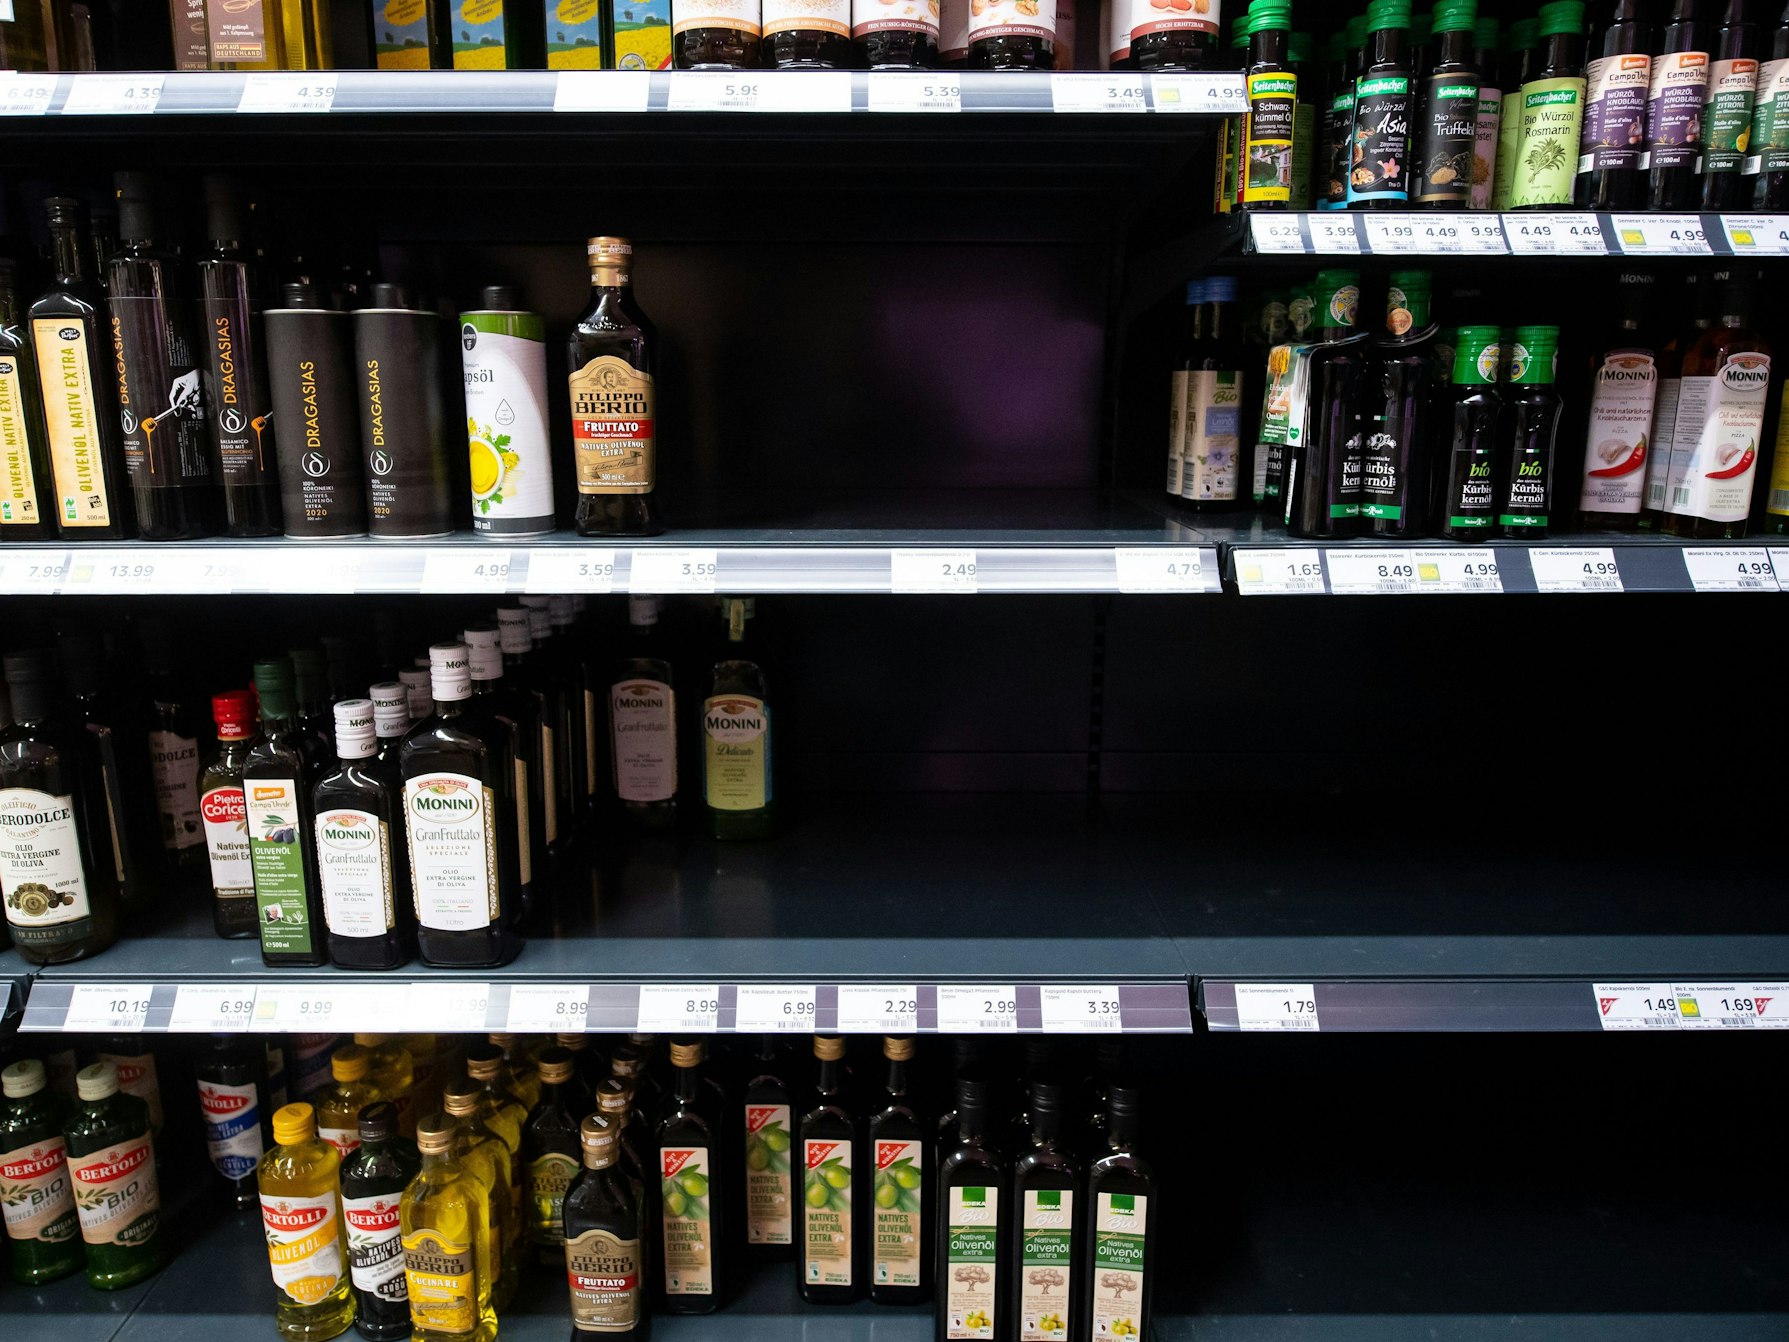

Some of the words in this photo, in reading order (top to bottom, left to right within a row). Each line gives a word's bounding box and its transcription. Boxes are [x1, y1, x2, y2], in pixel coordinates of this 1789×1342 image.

[1174, 21, 1204, 29] ERHITZBAR
[924, 86, 961, 97] 5.39
[1253, 80, 1295, 93] Seitenbacher
[1357, 80, 1406, 96] Seitenbacher
[1438, 86, 1477, 97] Seitenbacher
[1665, 87, 1693, 97] WÜRZÖL
[298, 87, 335, 98] 4.39
[1108, 88, 1144, 98] 3.49
[1207, 88, 1244, 98] 4.99
[1607, 90, 1635, 99] WÜRZÖL
[1717, 94, 1745, 102] WÜRZÖL
[1527, 93, 1574, 106] Seitenbacher
[1716, 101, 1745, 109] ZITRONE
[1259, 102, 1291, 112] Schwarz-
[1360, 104, 1371, 114] Bio
[1255, 114, 1283, 123] kümmel
[1434, 114, 1449, 122] Bio
[1524, 115, 1536, 125] Bio
[1541, 111, 1575, 122] Würzöl
[1377, 113, 1407, 135] Asia
[1525, 125, 1571, 138] Rosmarin
[1270, 227, 1300, 236] 6.29
[1325, 227, 1355, 236] 3.99
[1382, 227, 1412, 236] 1.99
[1426, 228, 1456, 237] 4.49
[1472, 227, 1502, 236] 9.99
[1521, 226, 1551, 236] 4.49
[1570, 226, 1600, 236] 4.49
[1670, 230, 1706, 241] 4.99
[111, 317, 130, 405] DRAGASIAS
[216, 317, 237, 405] DRAGASIAS
[61, 347, 80, 388] EXTRA
[1604, 371, 1650, 381] MONINI
[1726, 372, 1767, 382] MONINI
[579, 393, 643, 401] FILIPPO
[301, 362, 322, 448] DRAGASIAS
[368, 360, 385, 446] DRAGASIAS
[575, 402, 647, 413] BERIO
[67, 393, 85, 428] NATIV
[2, 416, 19, 446] NATIV
[584, 422, 639, 432] FRUTTATO
[601, 449, 624, 457] EXTRA
[1519, 461, 1542, 476] bio
[1463, 485, 1492, 494] Kürbis
[1512, 484, 1544, 493] Kürbis
[1511, 493, 1544, 502] kernöl
[29, 566, 63, 577] 7.99
[110, 566, 155, 577] 13.99
[474, 564, 509, 576] 4.99
[579, 564, 613, 576] 3.59
[682, 564, 716, 576] 3.59
[942, 564, 977, 576] 2.49
[1166, 563, 1202, 576] 4.79
[1288, 564, 1321, 576] 1.65
[1378, 565, 1413, 577] 8.49
[1464, 564, 1498, 576] 4.99
[1583, 563, 1617, 575] 4.99
[1738, 563, 1772, 575] 4.99
[619, 697, 663, 708] MONINI
[707, 716, 761, 730] MONINI
[256, 790, 282, 799] demeter
[417, 798, 473, 810] MONINI
[325, 828, 371, 840] MONINI
[416, 828, 480, 842] GranFruttato
[217, 842, 250, 851] Natives
[255, 847, 291, 855] OLIVENÖL
[24, 849, 60, 859] VERGINE
[325, 852, 377, 864] GranFruttato
[109, 1000, 150, 1013] 10.19
[220, 1001, 253, 1013] 6.99
[300, 1002, 332, 1014] 9.99
[555, 1002, 588, 1015] 8.99
[686, 1000, 718, 1013] 8.99
[784, 1002, 815, 1015] 6.99
[885, 1000, 917, 1013] 2.29
[984, 1001, 1016, 1014] 2.99
[1088, 1002, 1120, 1014] 3.39
[1283, 1001, 1315, 1013] 1.79
[1644, 999, 1676, 1011] 1.49
[1721, 999, 1753, 1011] 1.69
[80, 1148, 149, 1181] BERTOLLI
[30, 1178, 64, 1206] BIO
[108, 1181, 139, 1210] BIO
[750, 1195, 773, 1204] EXTRA
[809, 1214, 839, 1222] NATIVES
[878, 1214, 908, 1223] NATIVES
[960, 1210, 989, 1223] Bio
[1034, 1213, 1064, 1226] Bio
[668, 1222, 698, 1231] NATIVES
[809, 1224, 844, 1233] OLIVENÖL
[878, 1224, 913, 1233] OLIVENÖL
[1108, 1216, 1138, 1230] Bio
[668, 1232, 702, 1241] OLIVENÖL
[809, 1234, 832, 1243] EXTRA
[878, 1235, 901, 1243] EXTRA
[668, 1243, 692, 1252] EXTRA
[951, 1240, 995, 1250] Olivenöl
[1026, 1244, 1070, 1253] Olivenöl
[1108, 1240, 1134, 1249] Natives
[1098, 1247, 1143, 1259] Olivenöl
[407, 1254, 460, 1265] FILIPPO
[574, 1256, 630, 1264] FILIPPO
[406, 1260, 464, 1273] BERIO
[570, 1263, 633, 1272] BERIO
[578, 1277, 625, 1287] FRUTTATO
